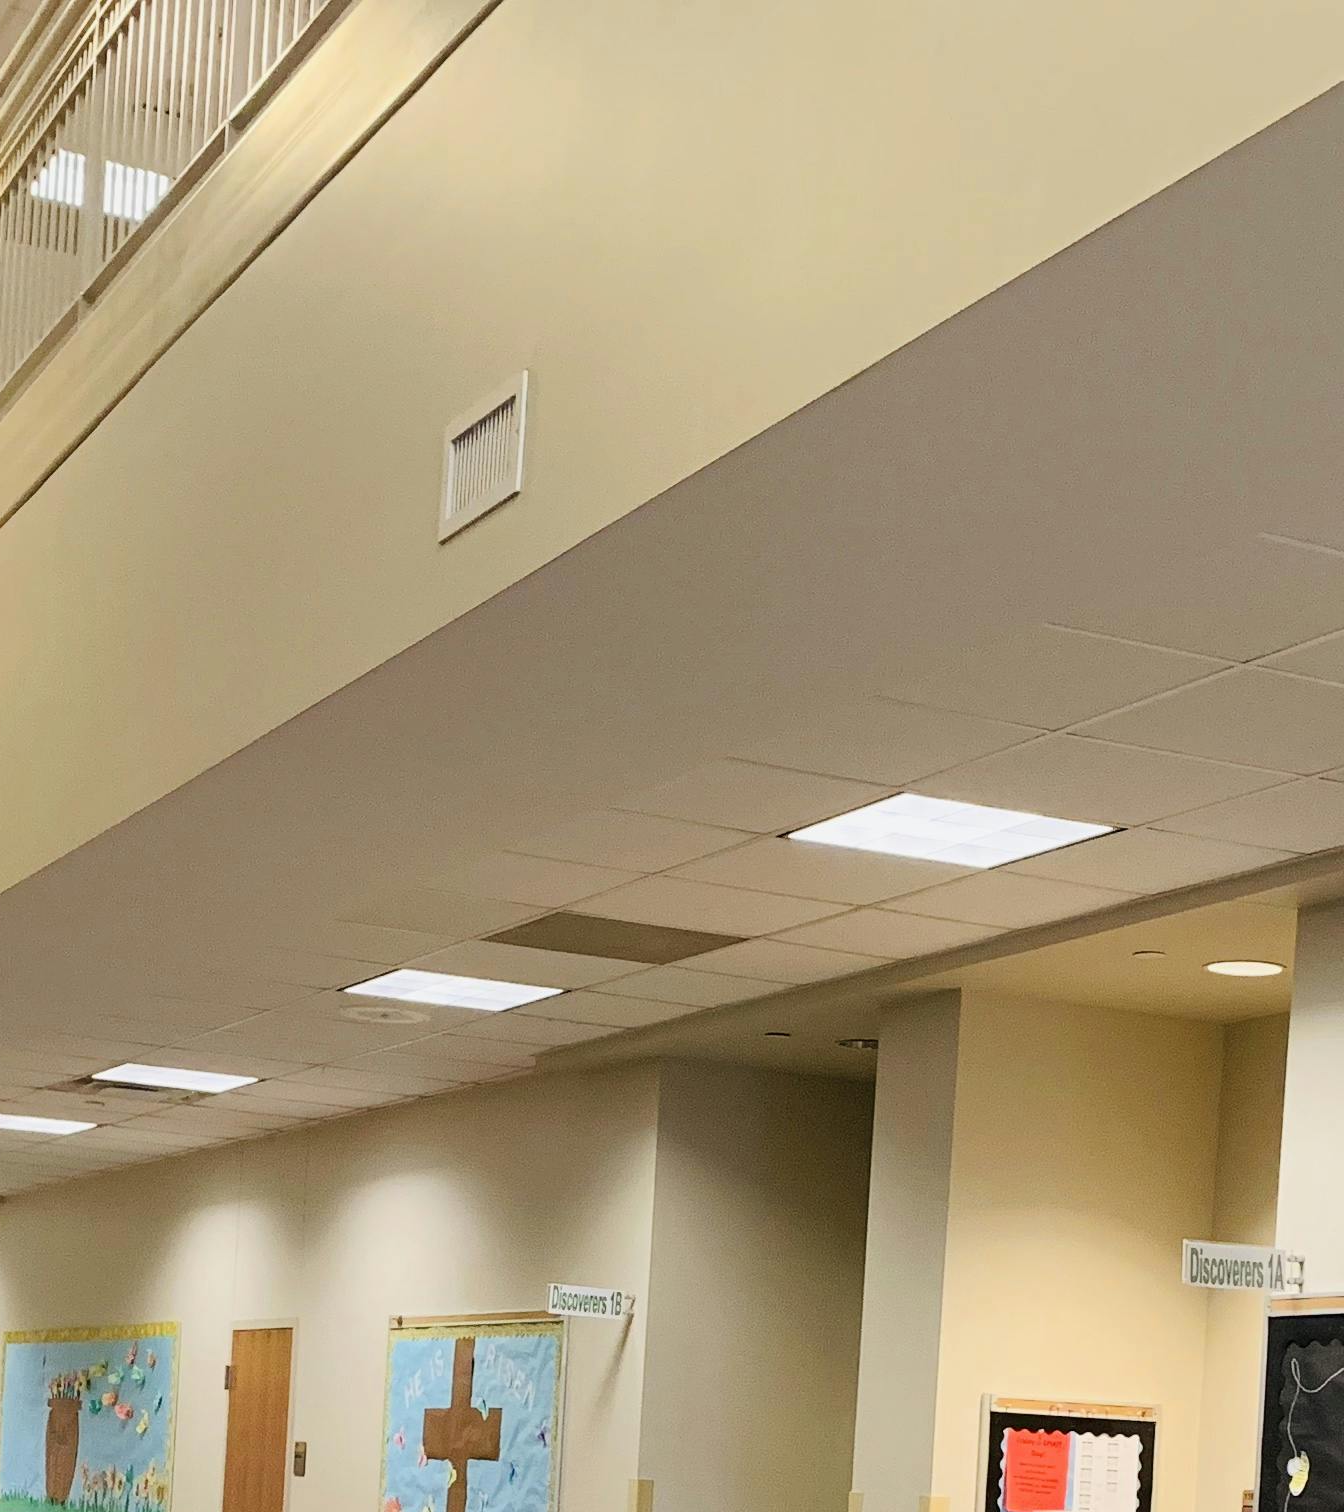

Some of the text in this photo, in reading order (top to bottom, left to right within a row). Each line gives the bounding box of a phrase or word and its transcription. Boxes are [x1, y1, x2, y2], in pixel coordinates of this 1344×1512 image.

[1189, 1246, 1285, 1291] Discoverers 1A
[551, 1284, 623, 1316] Discoverers 1B
[404, 1343, 537, 1412] HE IS RISEN
